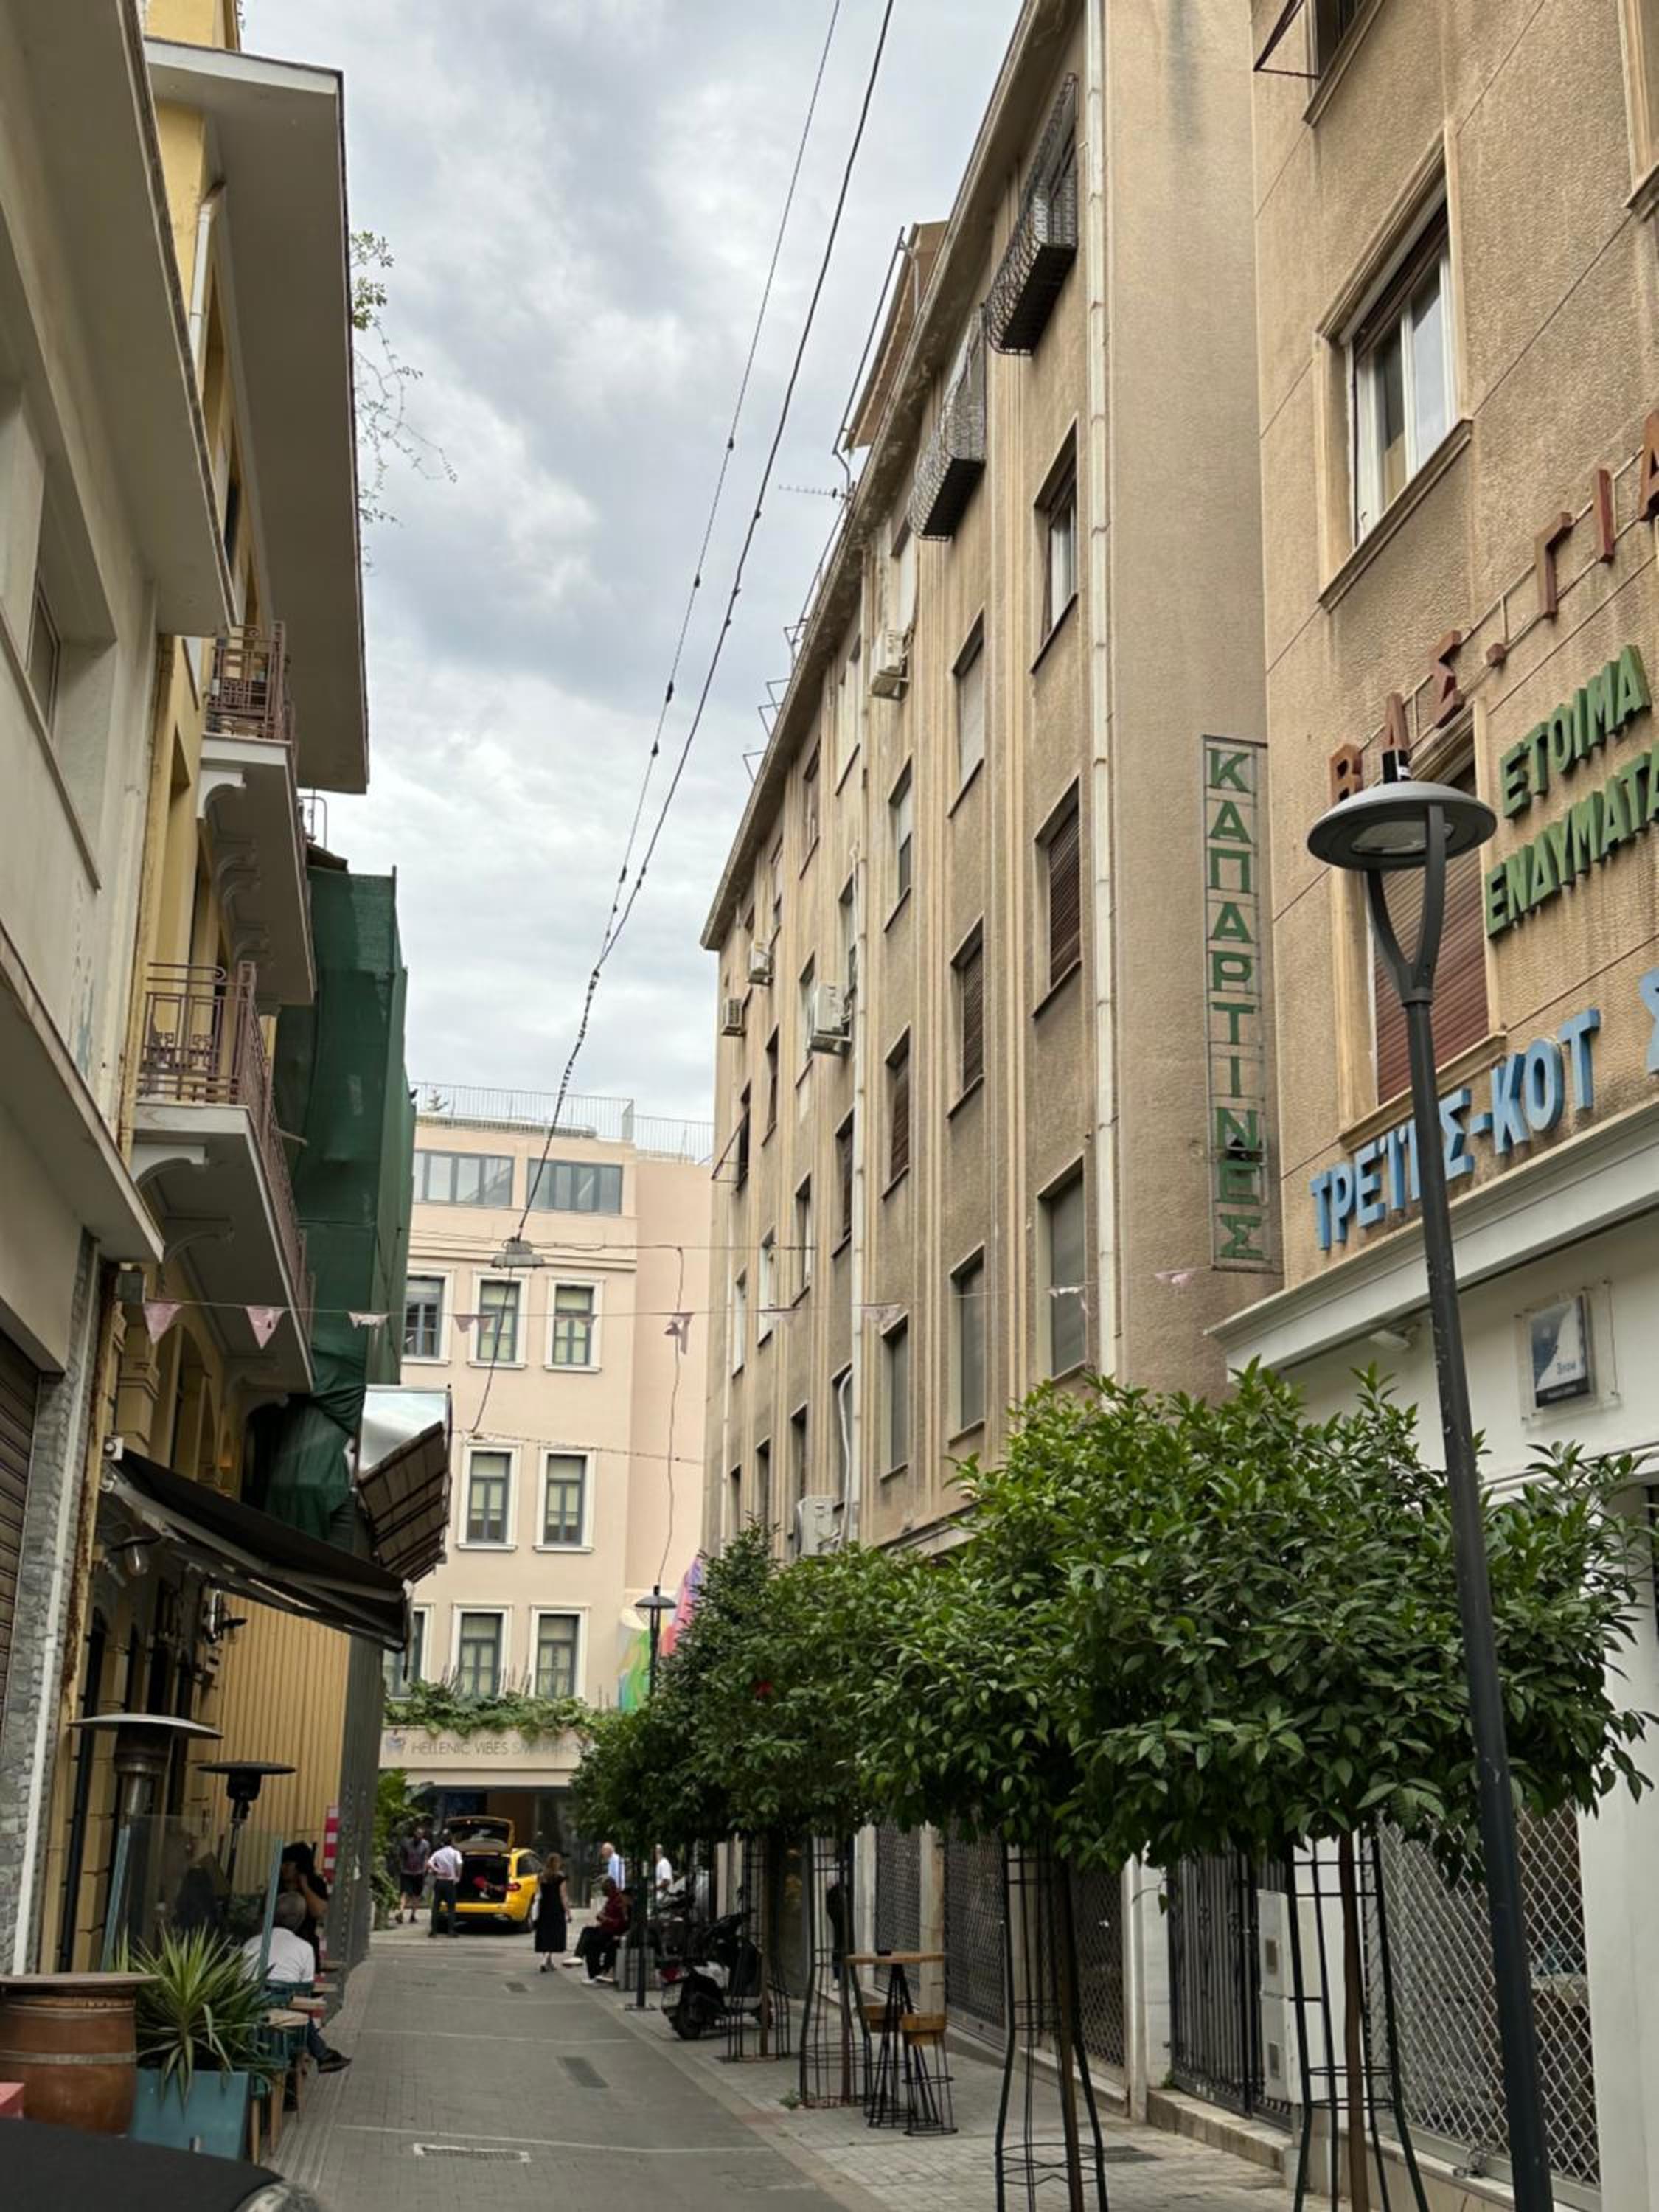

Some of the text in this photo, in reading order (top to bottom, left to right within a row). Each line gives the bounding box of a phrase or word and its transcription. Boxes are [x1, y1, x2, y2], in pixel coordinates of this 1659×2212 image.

[1500, 644, 1652, 820] ΕΤΟΙΜΑ
[1207, 746, 1266, 1260] ΚΑΠΑΡΤΙΝΕΣ
[411, 1740, 470, 1756] HELLENIC
[474, 1740, 509, 1756] VIBES
